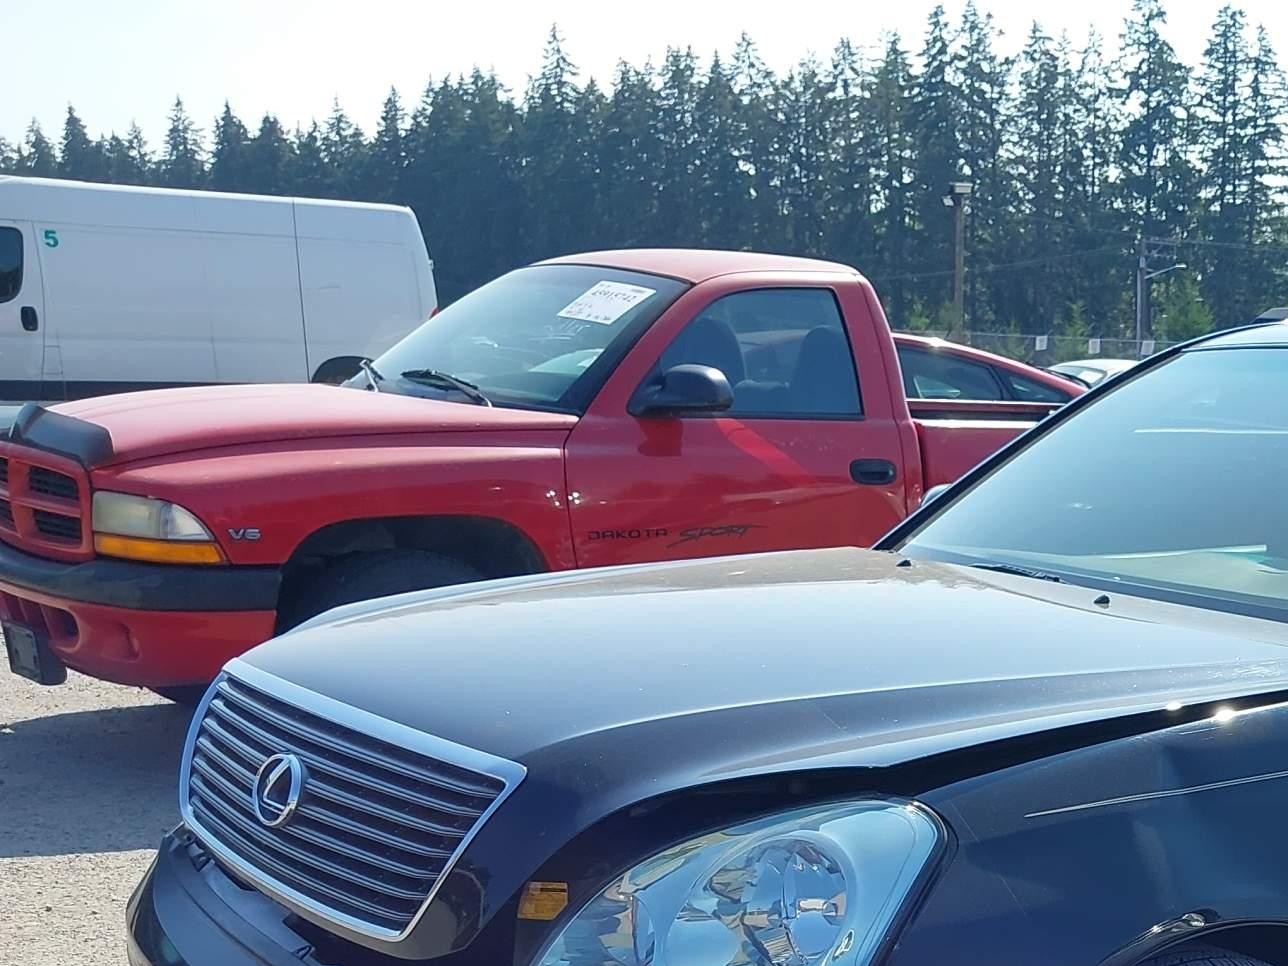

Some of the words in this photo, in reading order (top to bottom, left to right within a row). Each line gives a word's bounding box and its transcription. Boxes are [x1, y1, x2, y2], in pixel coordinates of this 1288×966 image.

[44, 230, 59, 248] 5
[228, 528, 262, 541] V6
[587, 528, 668, 541] DAKOTA
[668, 524, 767, 549] SPORT
